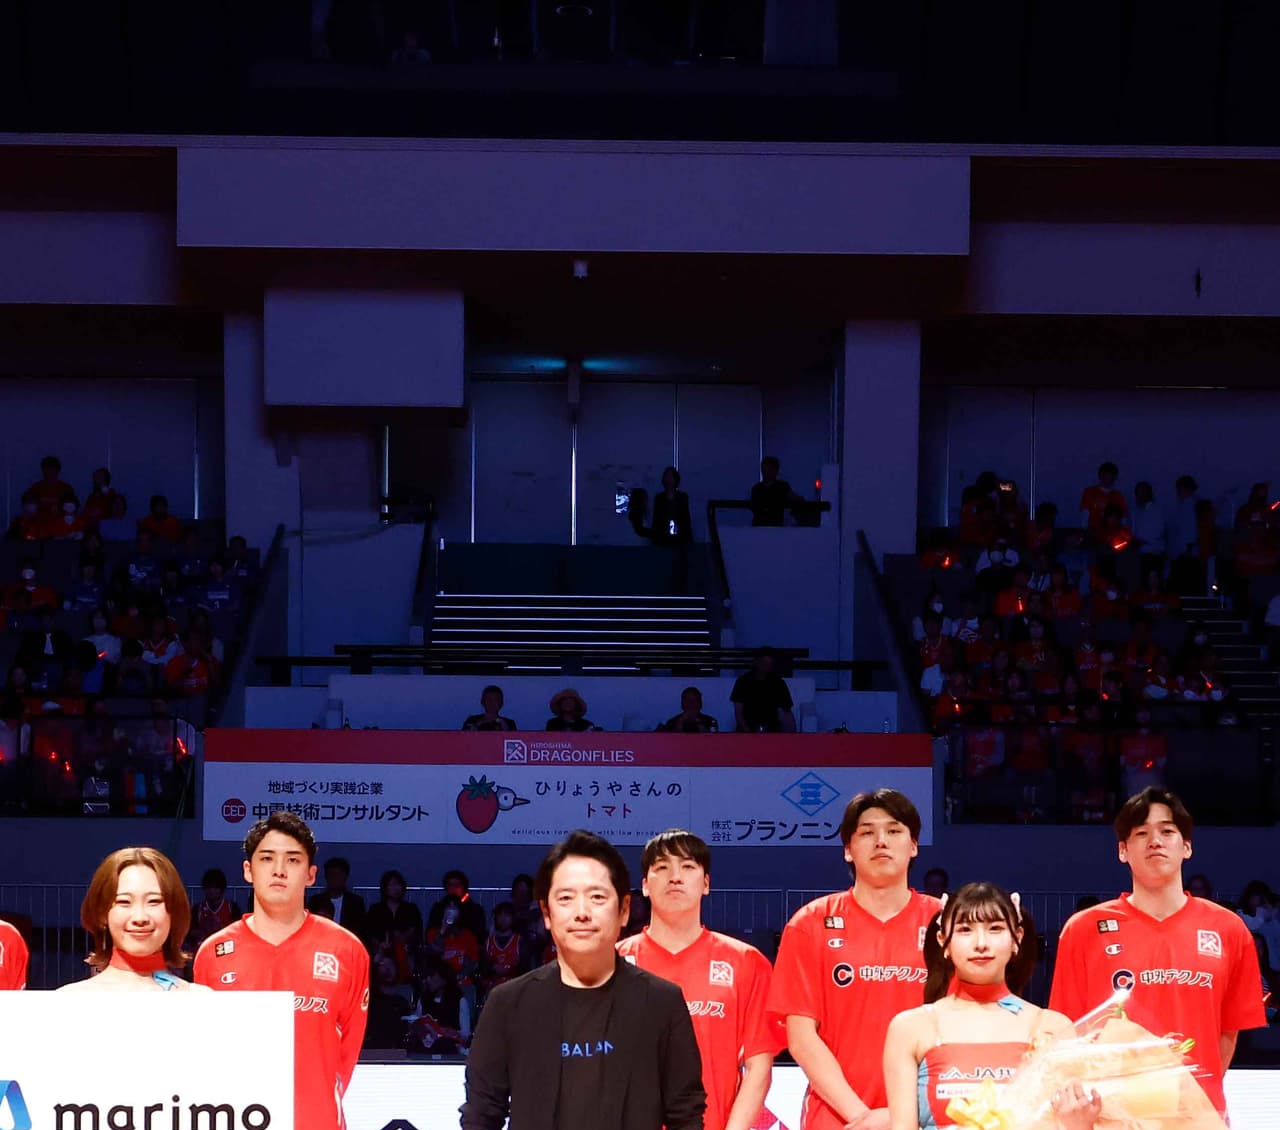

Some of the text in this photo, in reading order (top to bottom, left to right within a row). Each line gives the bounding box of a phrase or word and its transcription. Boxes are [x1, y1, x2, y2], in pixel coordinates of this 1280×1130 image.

[530, 750, 635, 762] DRAGONFLIES
[268, 781, 383, 795] 地域づくり実践企業
[588, 803, 632, 818] トマト
[1140, 969, 1213, 989] 中外テクノス
